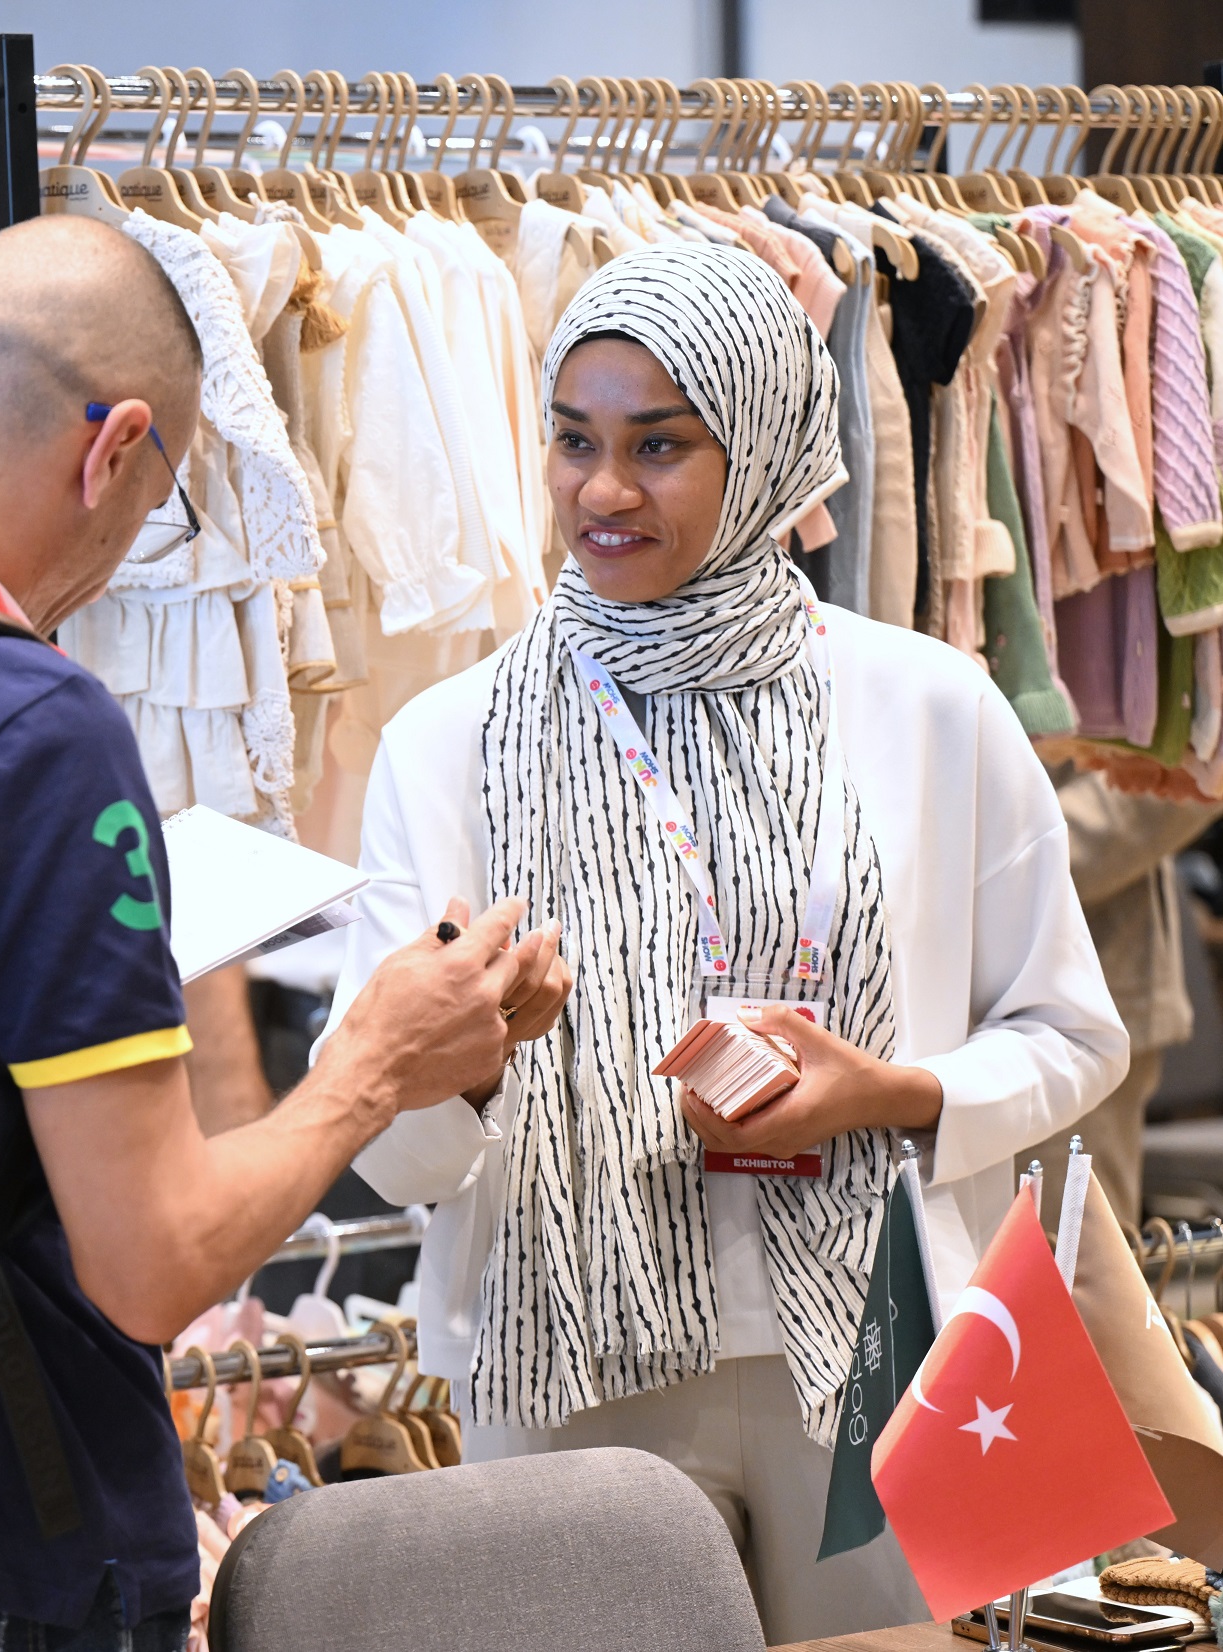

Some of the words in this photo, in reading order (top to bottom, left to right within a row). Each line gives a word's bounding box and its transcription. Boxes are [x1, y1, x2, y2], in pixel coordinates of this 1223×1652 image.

[602, 682, 620, 704] SHOW
[639, 751, 659, 775] SHOW
[680, 824, 698, 848] SHOW
[92, 799, 162, 931] 3
[701, 936, 713, 963] SHOW
[811, 947, 819, 973] SHOW
[733, 1158, 795, 1170] EXHIBITOR
